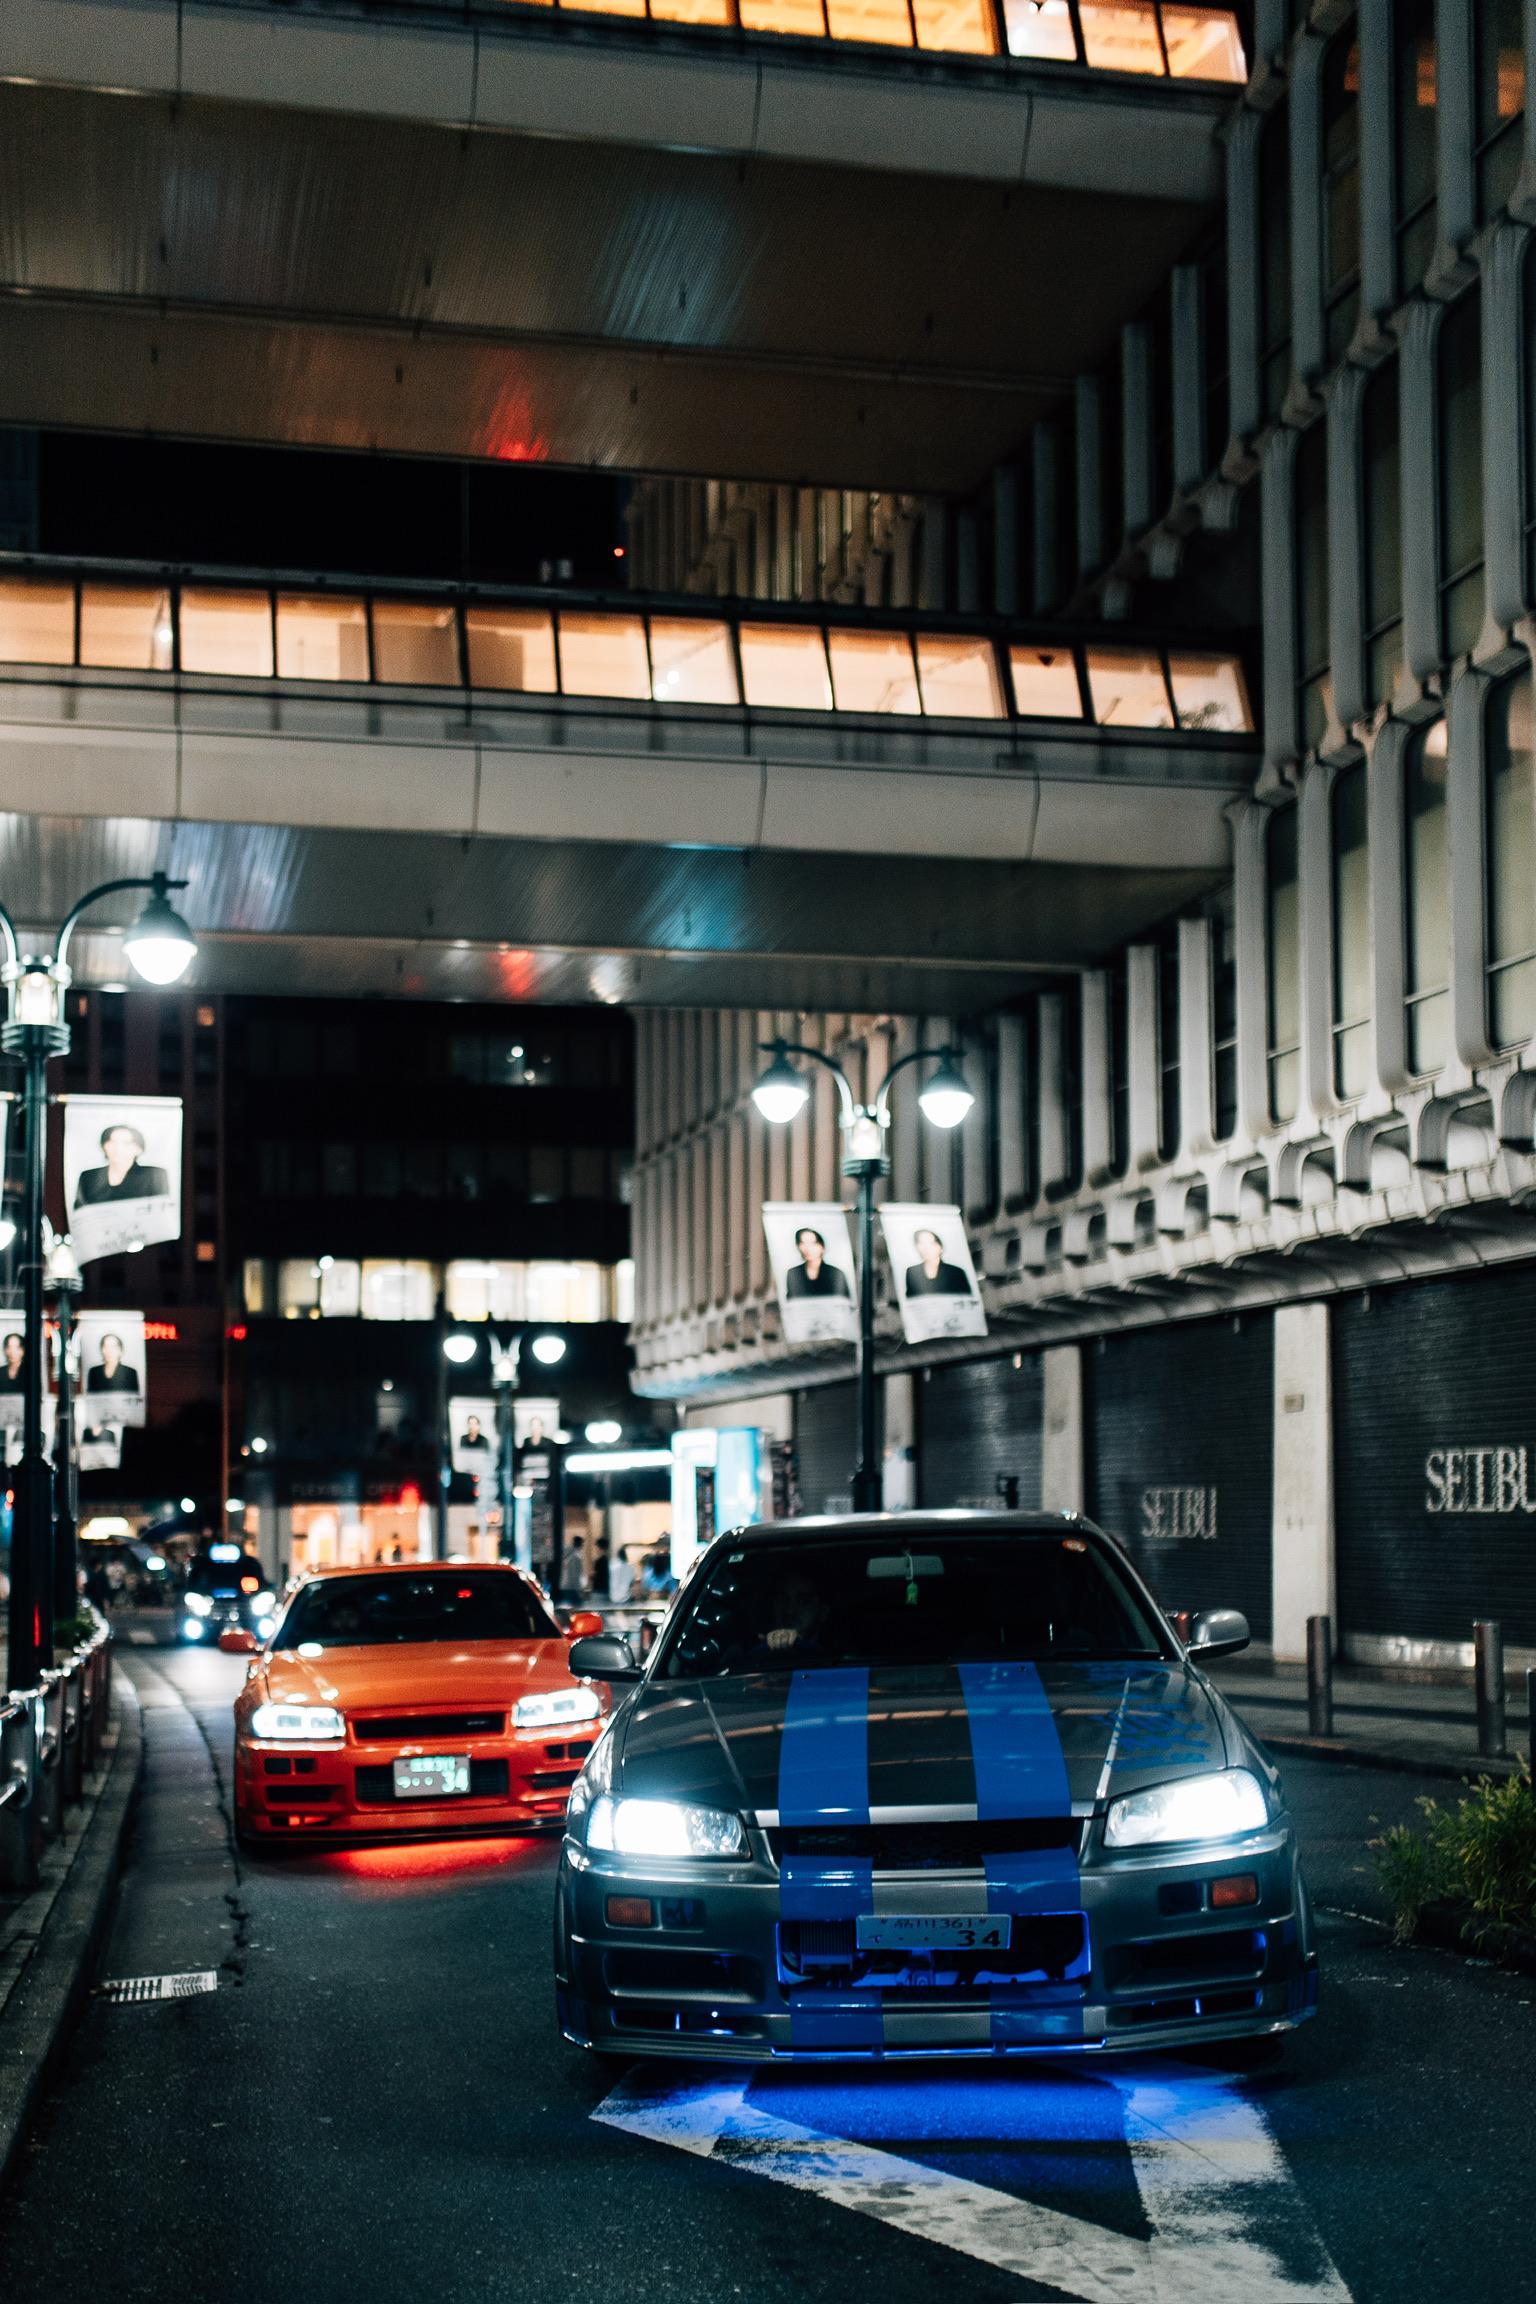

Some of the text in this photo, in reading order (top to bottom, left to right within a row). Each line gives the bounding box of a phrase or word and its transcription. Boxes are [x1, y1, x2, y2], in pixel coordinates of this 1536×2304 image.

[143, 1322, 177, 1340] OTEL
[1424, 1445, 1536, 1513] SEIBU
[1140, 1486, 1217, 1539] SEIBU
[956, 1929, 1002, 1947] 34
